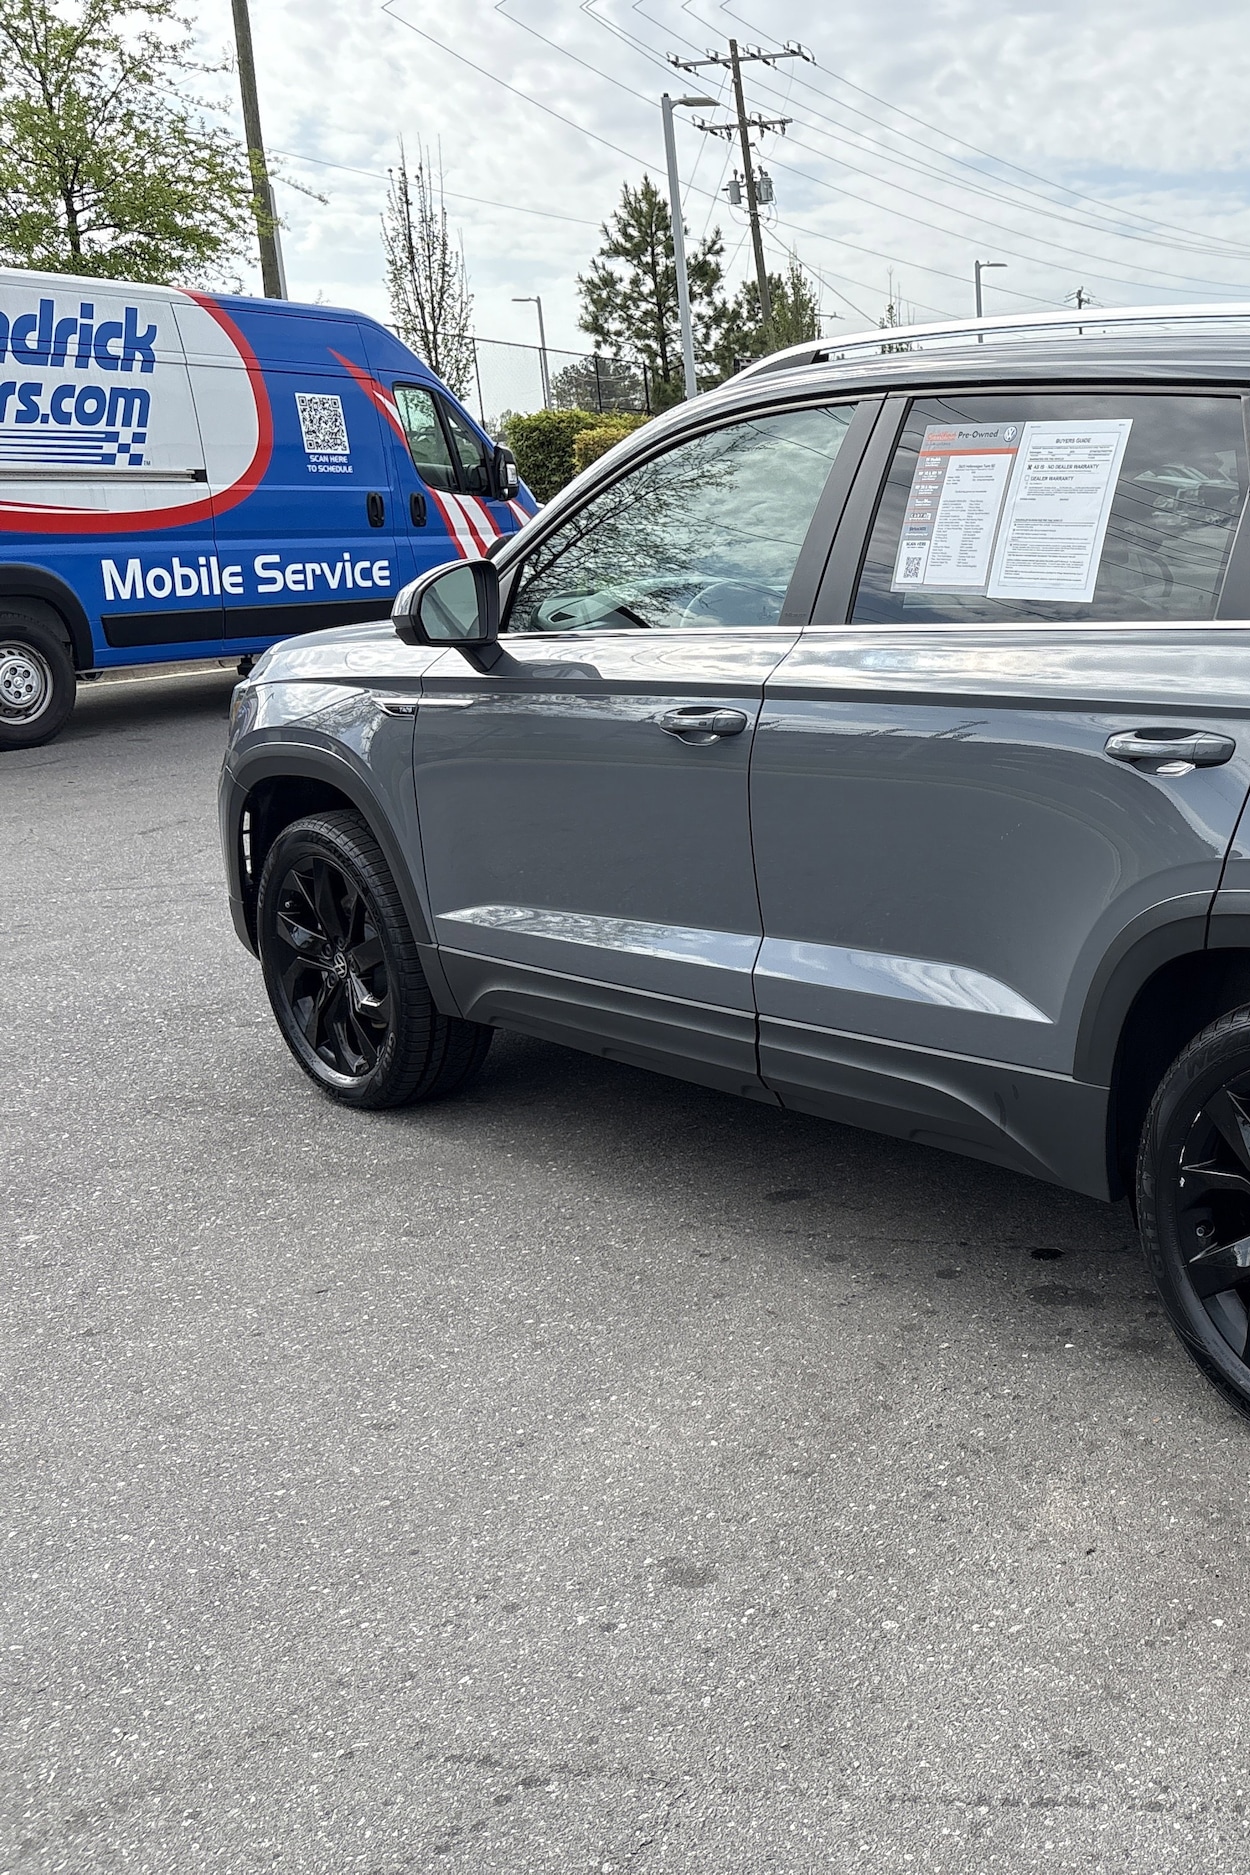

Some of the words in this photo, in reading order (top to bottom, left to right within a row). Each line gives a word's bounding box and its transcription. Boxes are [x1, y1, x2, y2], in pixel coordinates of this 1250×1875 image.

[958, 429, 1000, 439] Pre-Owned
[309, 455, 329, 463] SCAN
[330, 455, 348, 464] HERE
[307, 464, 317, 473] TO
[318, 464, 353, 473] SCHEDULE
[101, 556, 244, 600] Mobile
[254, 552, 391, 593] Service
